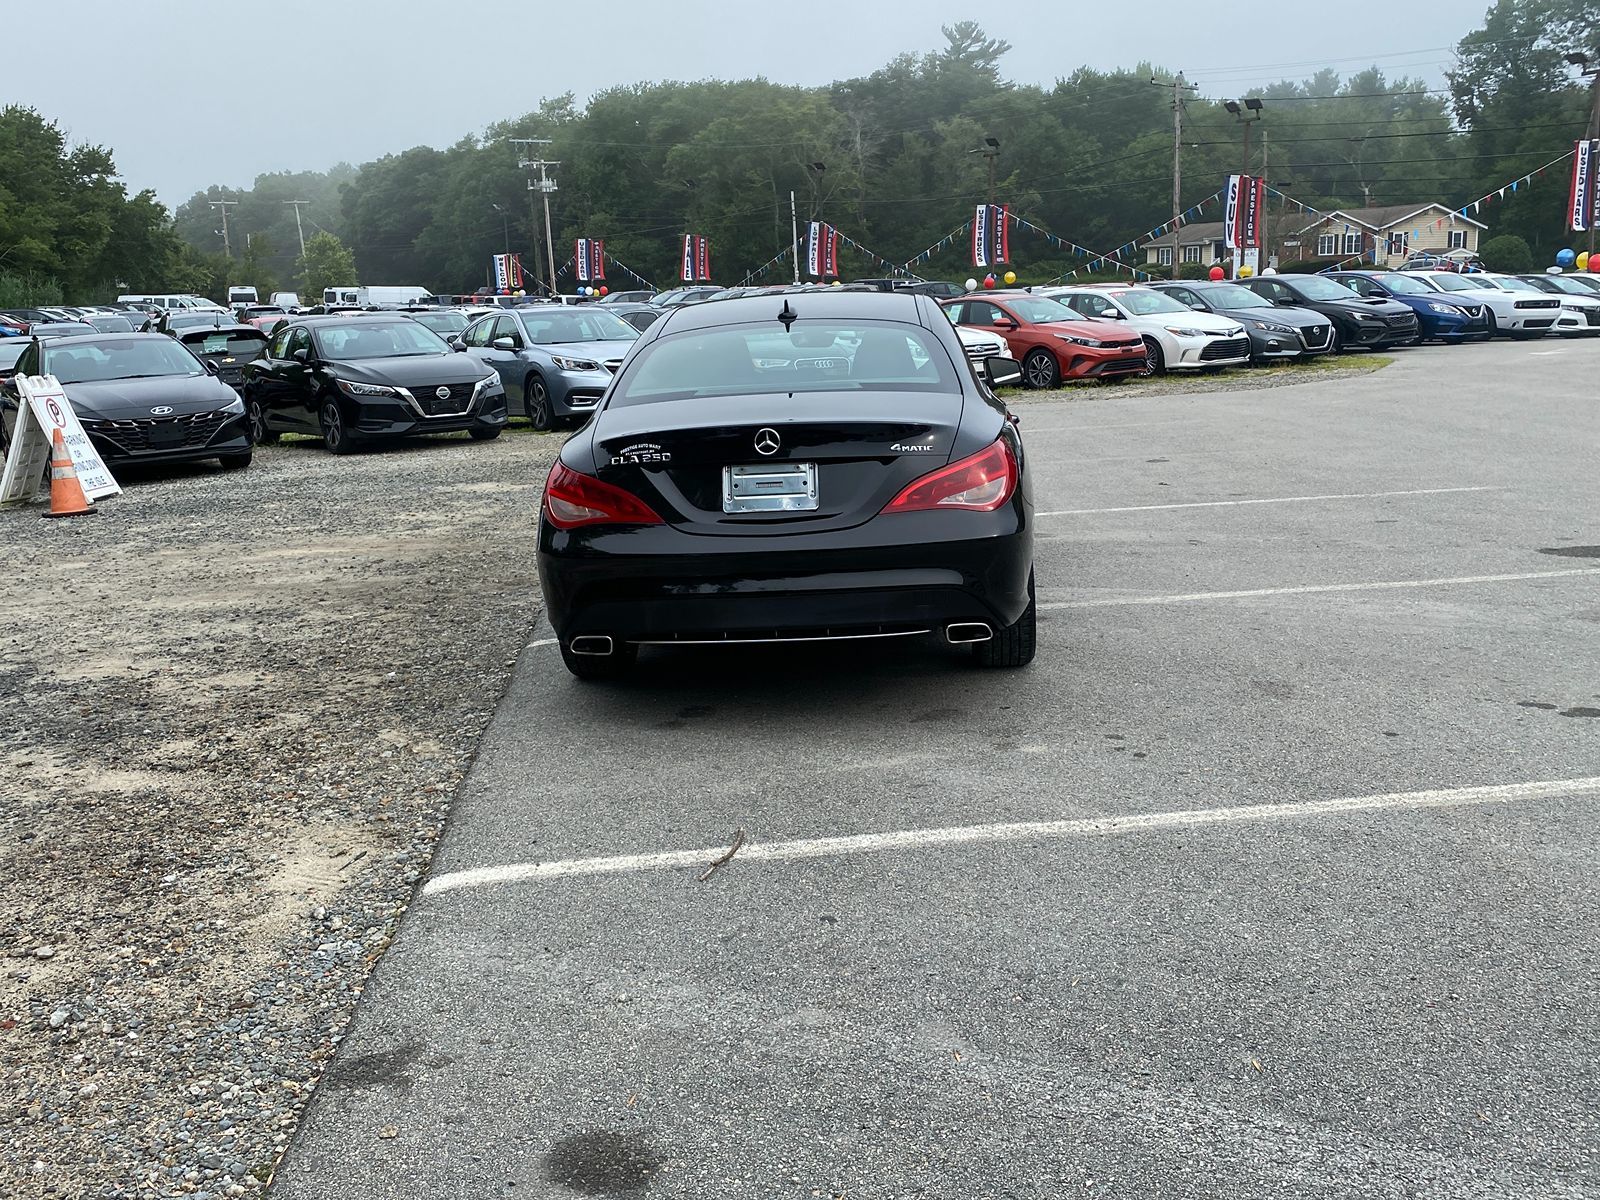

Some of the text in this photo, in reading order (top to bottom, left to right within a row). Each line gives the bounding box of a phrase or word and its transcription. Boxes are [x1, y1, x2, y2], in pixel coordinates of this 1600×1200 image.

[1574, 147, 1587, 226] USED CARS
[1227, 183, 1237, 241] SUV
[1247, 180, 1256, 236] PRESTIGE
[976, 231, 984, 263] TRUCKS
[498, 256, 507, 288] WELCOM
[611, 453, 671, 465] CLA 250
[890, 443, 934, 452] 4MATIC
